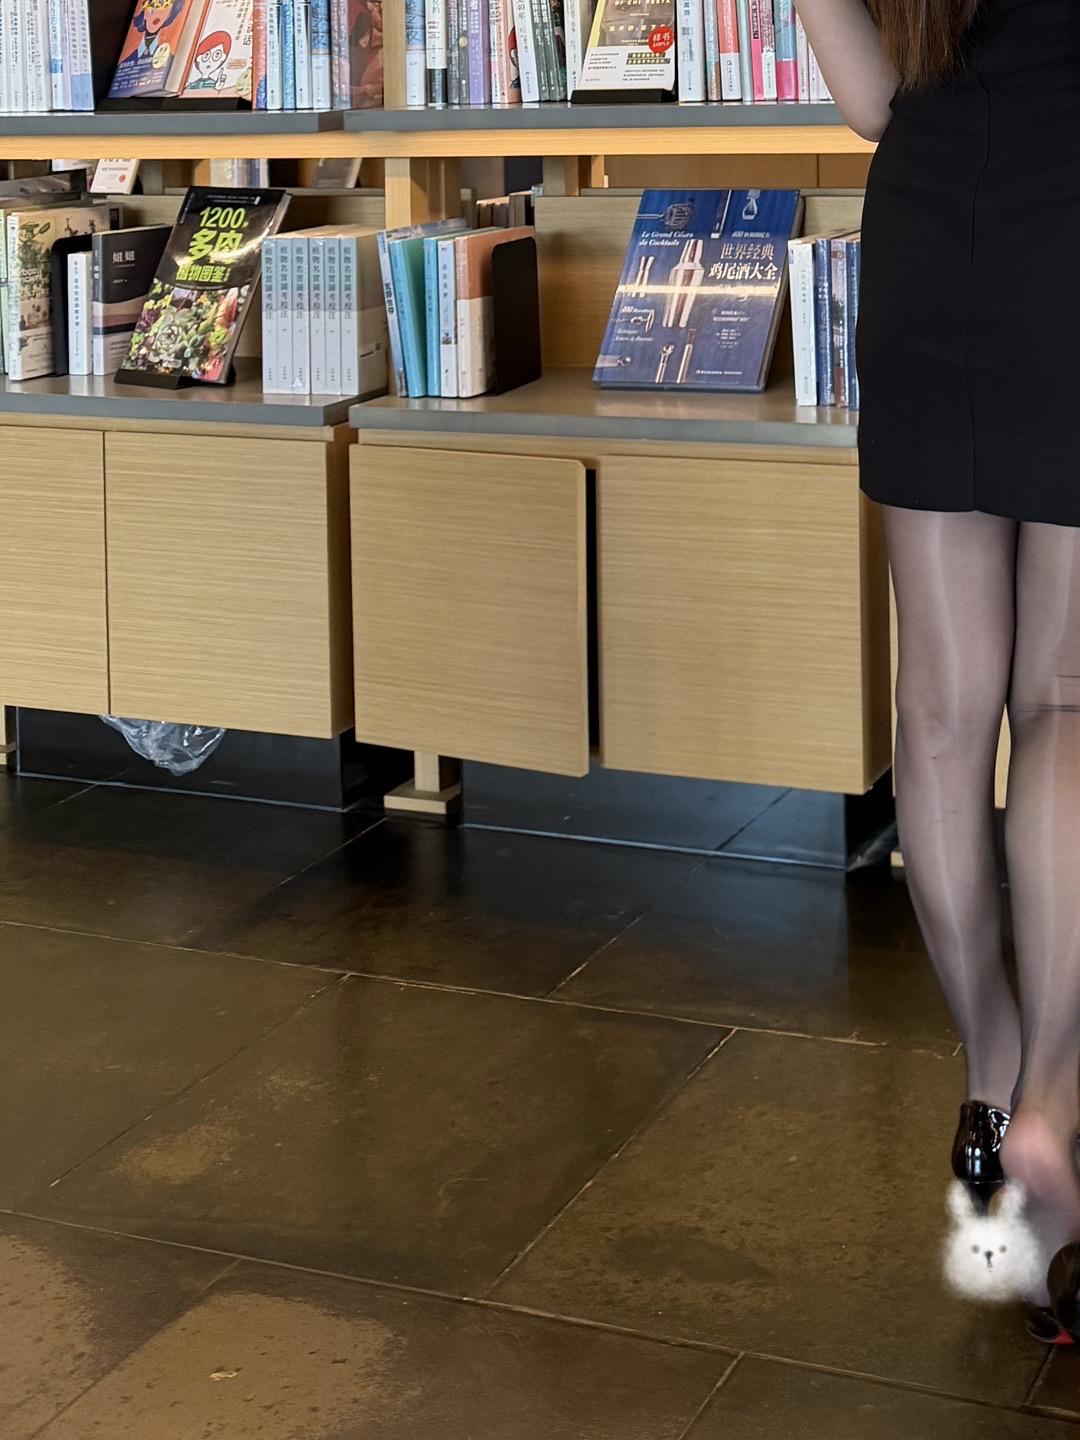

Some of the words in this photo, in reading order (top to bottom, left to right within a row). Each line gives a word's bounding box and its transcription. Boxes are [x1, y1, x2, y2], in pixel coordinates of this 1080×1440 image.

[652, 31, 671, 42] 样书
[199, 207, 246, 229] 1200
[649, 239, 680, 247] Cocktails
[651, 231, 673, 239] Grand
[188, 228, 243, 264] 多肉
[721, 242, 775, 260] 世界经典
[175, 264, 227, 283] 植物图鉴
[708, 262, 779, 281] 鸡尾酒大全
